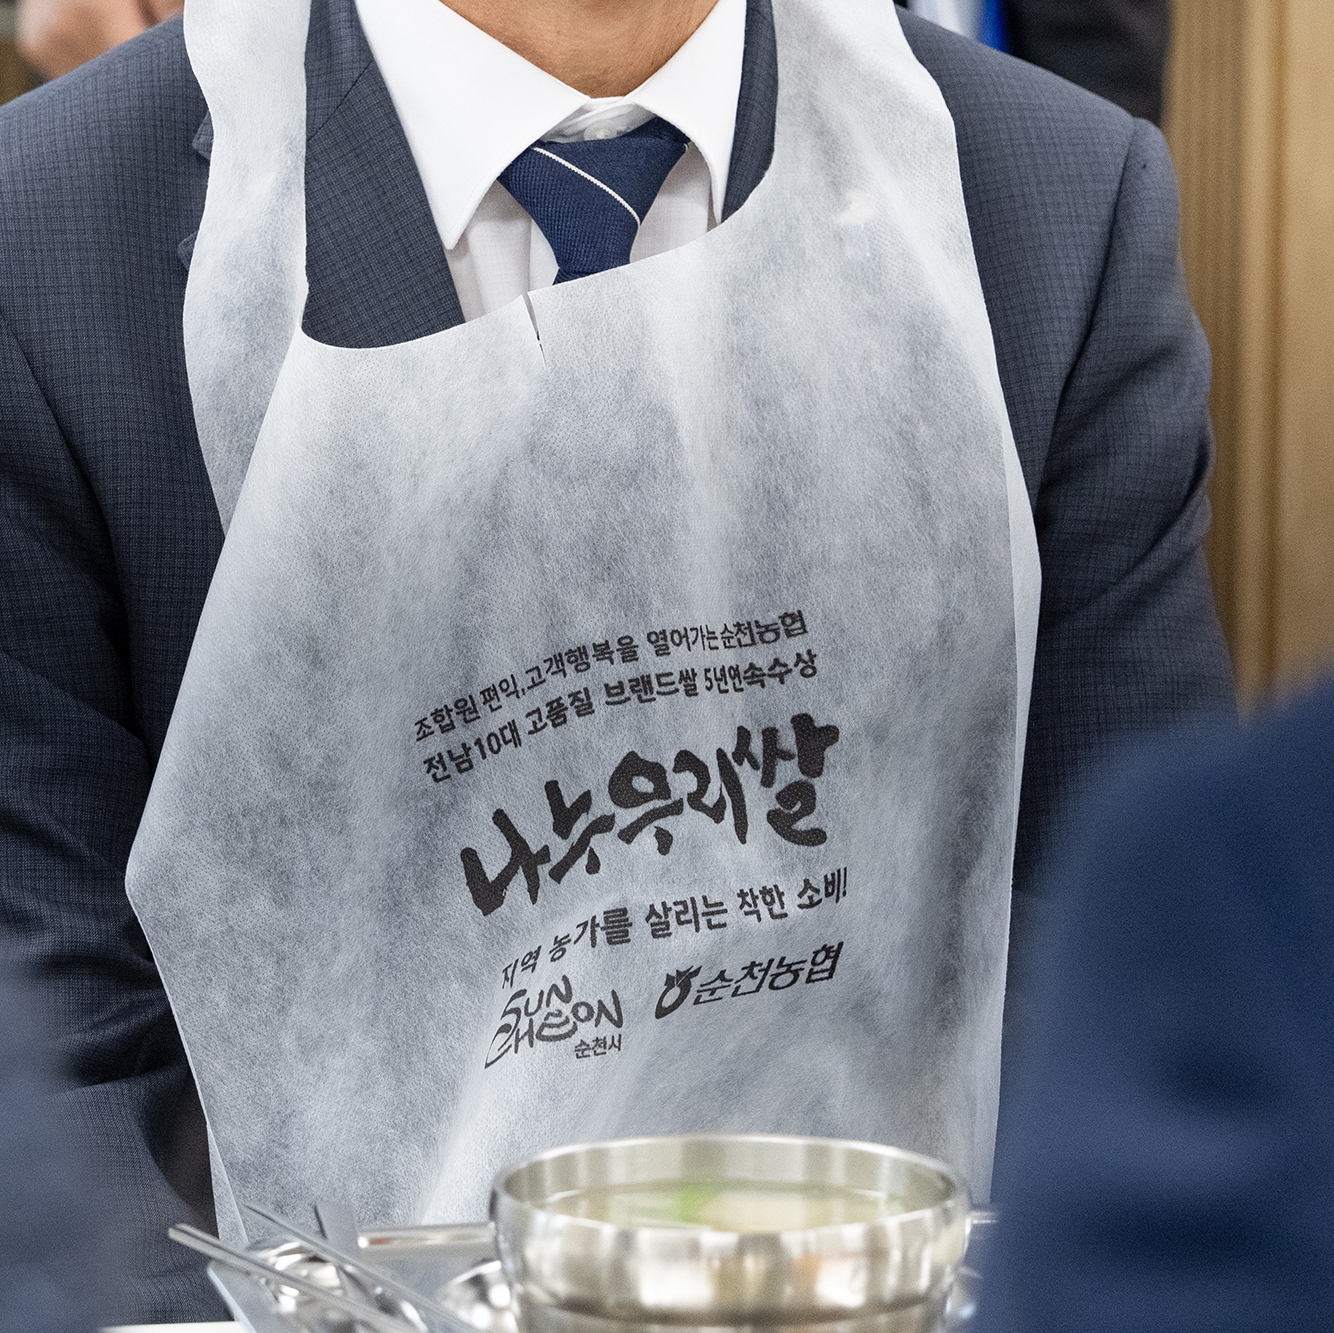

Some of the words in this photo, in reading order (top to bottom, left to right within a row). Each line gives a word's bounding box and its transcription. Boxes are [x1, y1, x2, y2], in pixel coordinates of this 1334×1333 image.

[414, 694, 481, 742] 조합원
[525, 686, 595, 736] 고품질
[603, 667, 700, 706] 브랜드쌀
[460, 712, 840, 916] 나누우리쌀
[502, 945, 542, 990] 지역
[548, 906, 633, 963] 농가를
[645, 894, 729, 939] 살리는
[736, 884, 789, 923] 착한
[797, 866, 848, 910] 소비!
[693, 940, 845, 1006] 순천농협
[498, 974, 573, 1040] SUN
[574, 1033, 623, 1059] 순천시
